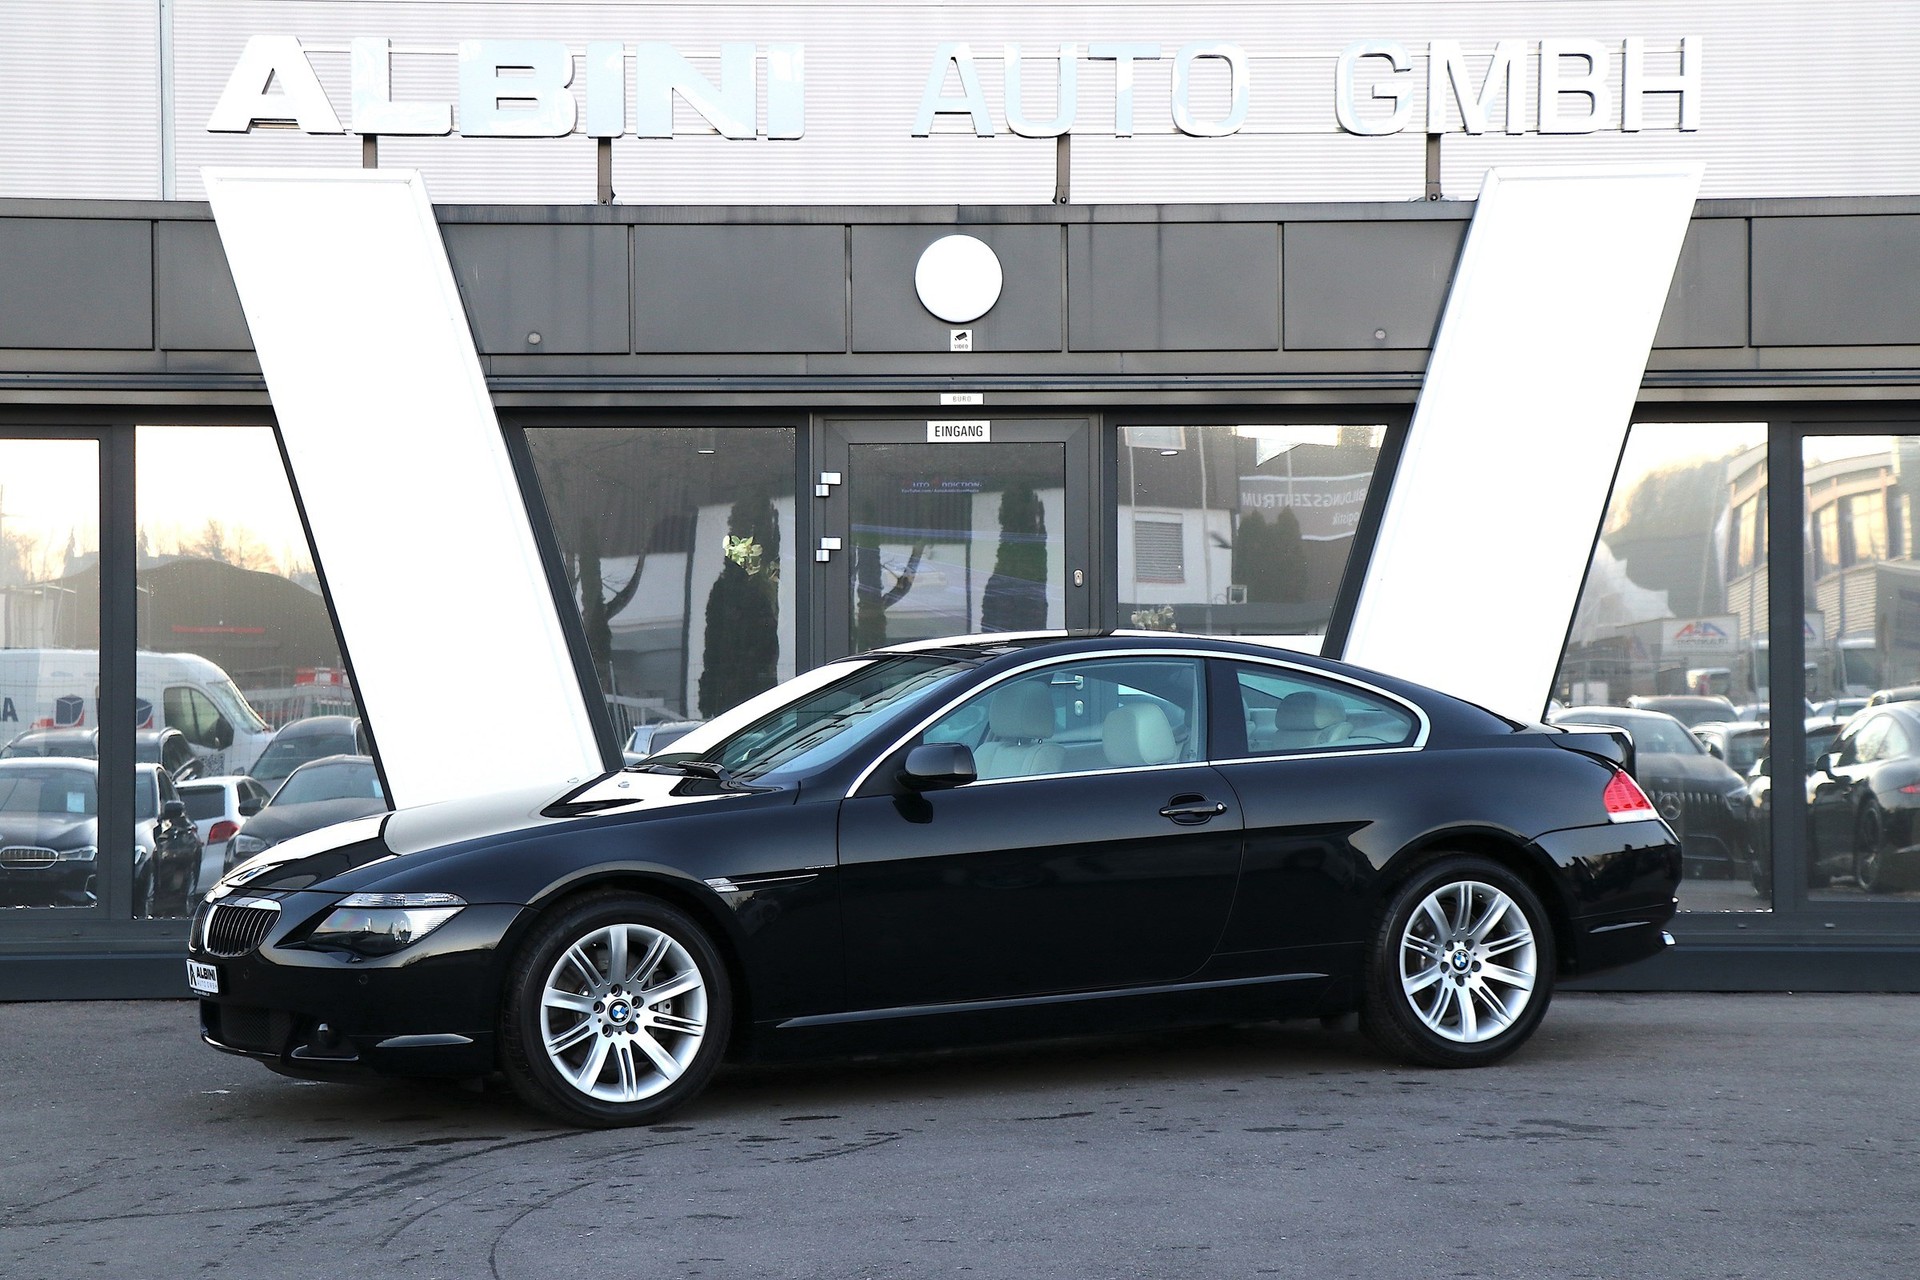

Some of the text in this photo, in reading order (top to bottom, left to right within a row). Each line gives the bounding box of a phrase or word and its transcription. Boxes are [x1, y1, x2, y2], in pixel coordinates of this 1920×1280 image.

[206, 34, 1703, 140] ALBINI AUTO GMBH
[935, 425, 983, 437] EINGANG
